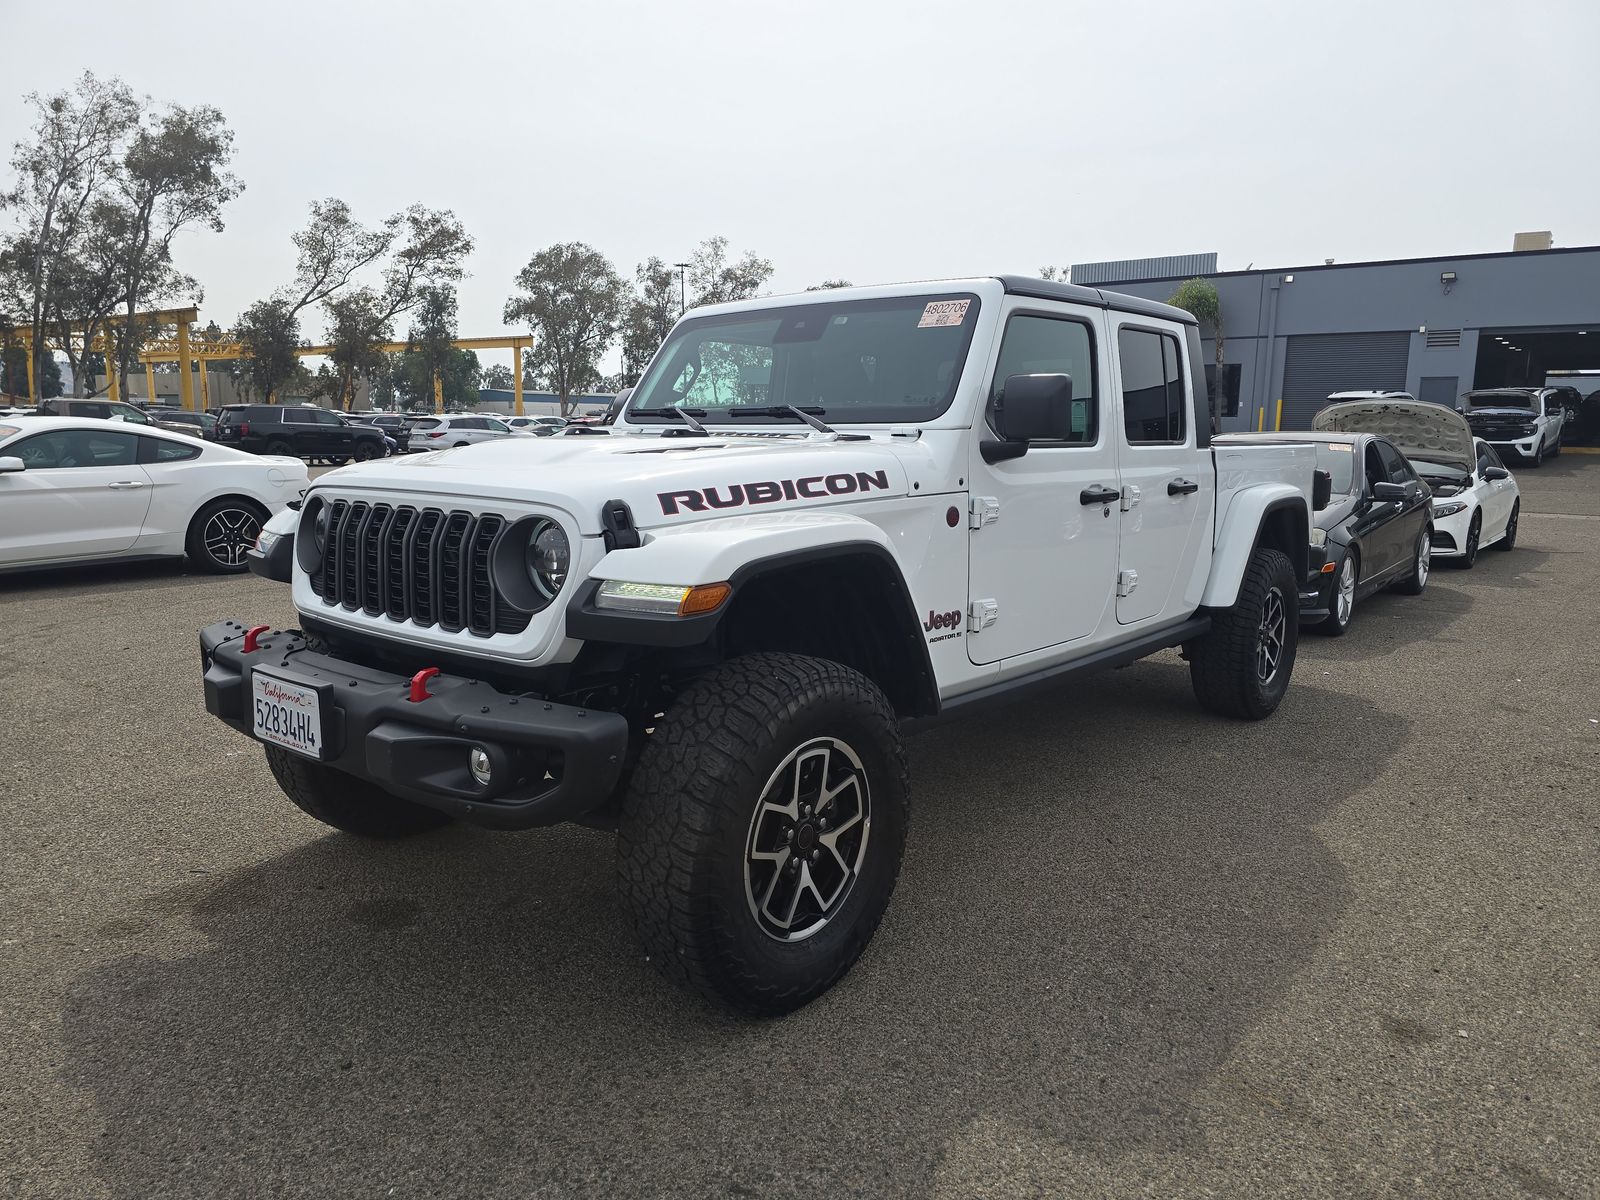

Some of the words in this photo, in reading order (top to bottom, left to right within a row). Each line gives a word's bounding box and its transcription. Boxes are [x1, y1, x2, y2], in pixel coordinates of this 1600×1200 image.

[925, 303, 968, 315] 4802706
[657, 470, 889, 516] RUBICON
[923, 610, 961, 632] Jeep
[264, 681, 305, 706] California
[256, 698, 315, 747] 52834H4
